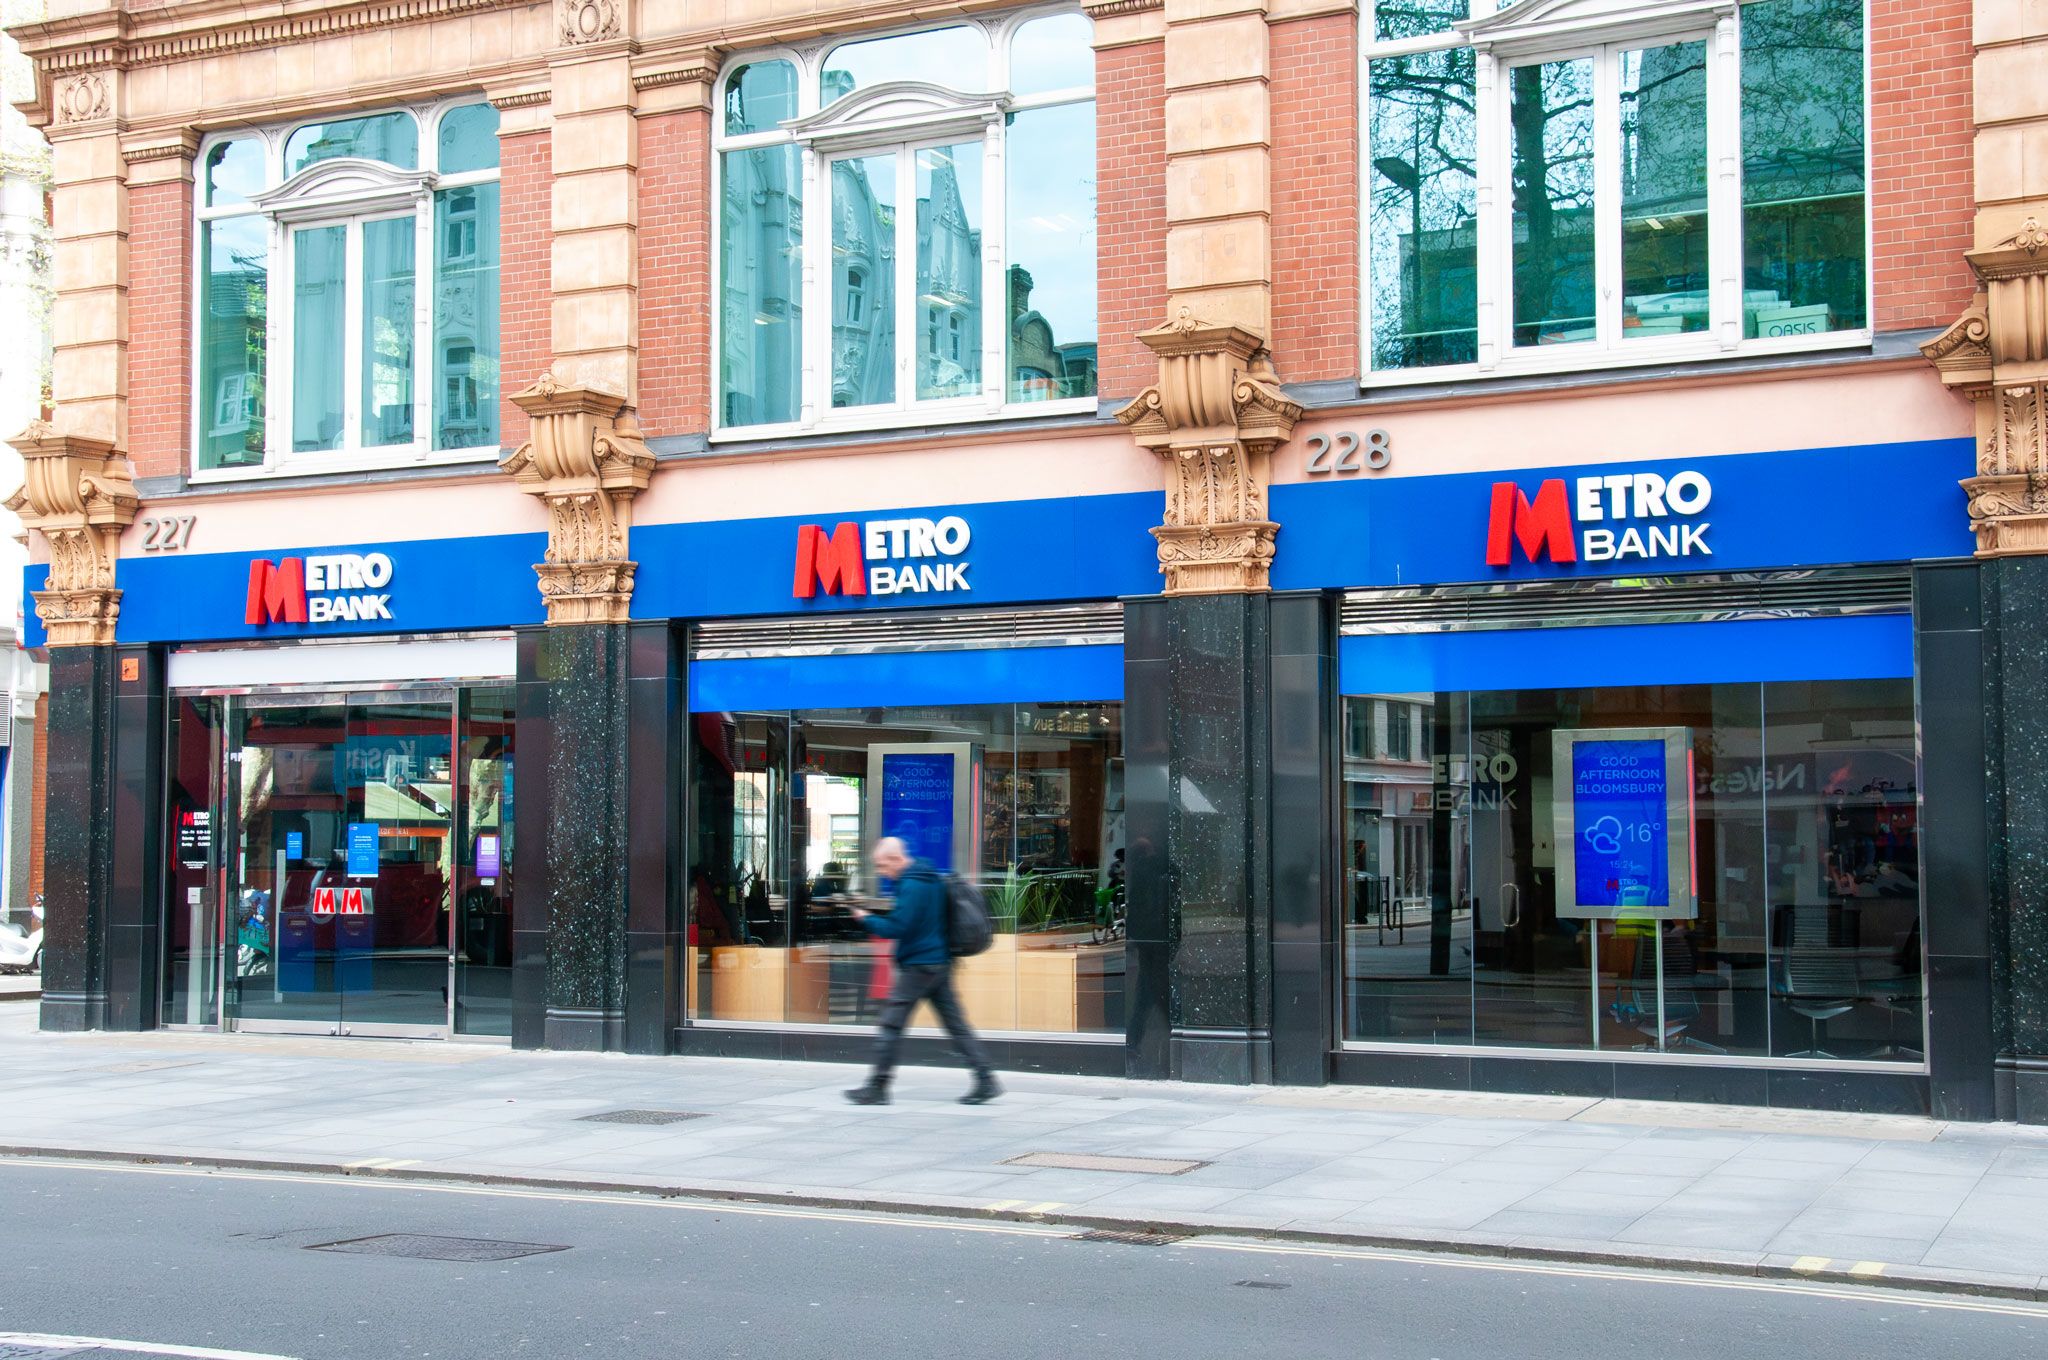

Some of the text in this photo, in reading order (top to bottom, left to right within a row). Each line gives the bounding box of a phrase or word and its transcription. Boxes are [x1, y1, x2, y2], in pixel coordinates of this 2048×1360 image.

[1769, 322, 1816, 338] OASIS
[1305, 428, 1392, 474] 228
[1486, 470, 1713, 566] METRO
[140, 515, 197, 550] 227
[1583, 522, 1713, 562] BANK
[793, 515, 972, 599] METRO
[244, 552, 393, 626] METRO
[870, 562, 972, 596] BANK
[308, 594, 393, 623] BANK
[903, 767, 935, 777] GOOD
[1600, 756, 1639, 767] GOOD
[887, 779, 950, 788] AFTERNOON
[1579, 769, 1660, 780] AFTERNOON
[884, 791, 954, 801] BLOOMSBURY
[1575, 783, 1665, 794] BLOOMSBURY
[1626, 822, 1661, 843] 16°
